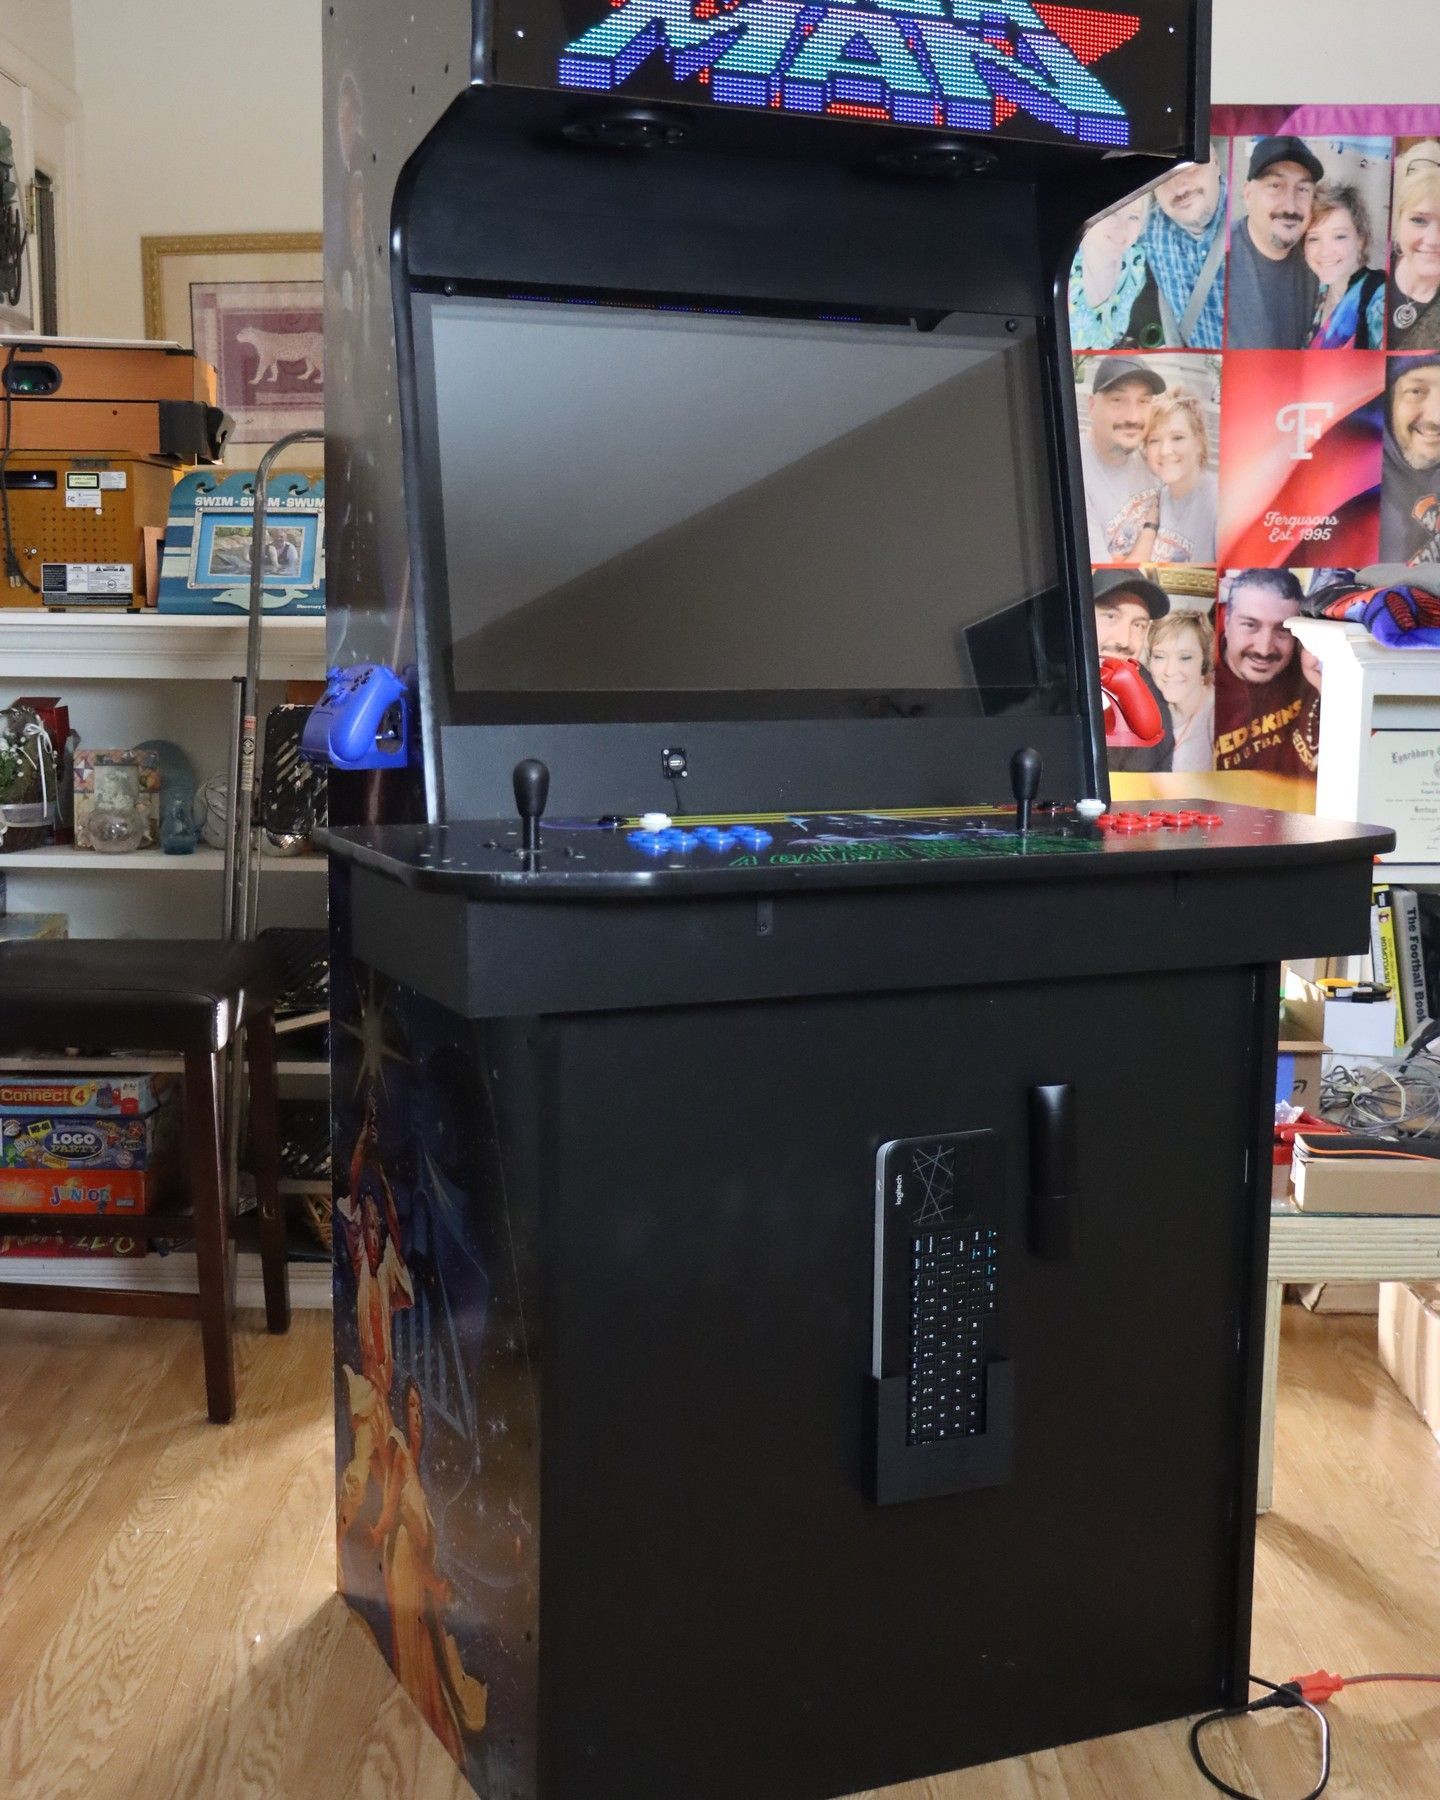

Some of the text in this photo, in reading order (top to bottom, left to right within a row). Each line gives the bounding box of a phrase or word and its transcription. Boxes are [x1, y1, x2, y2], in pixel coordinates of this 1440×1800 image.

[558, 0, 1130, 146] MAN
[1275, 401, 1334, 460] F
[194, 496, 325, 509] SWIM SWM SWUM
[1263, 511, 1339, 529] Fergusons
[1268, 527, 1332, 543] Est. 1995
[1406, 906, 1426, 1023] The Football Book
[1, 1088, 69, 1102] Connect
[52, 1133, 96, 1145] LOGO
[51, 1144, 100, 1153] PARTY
[895, 1174, 903, 1206] logitech
